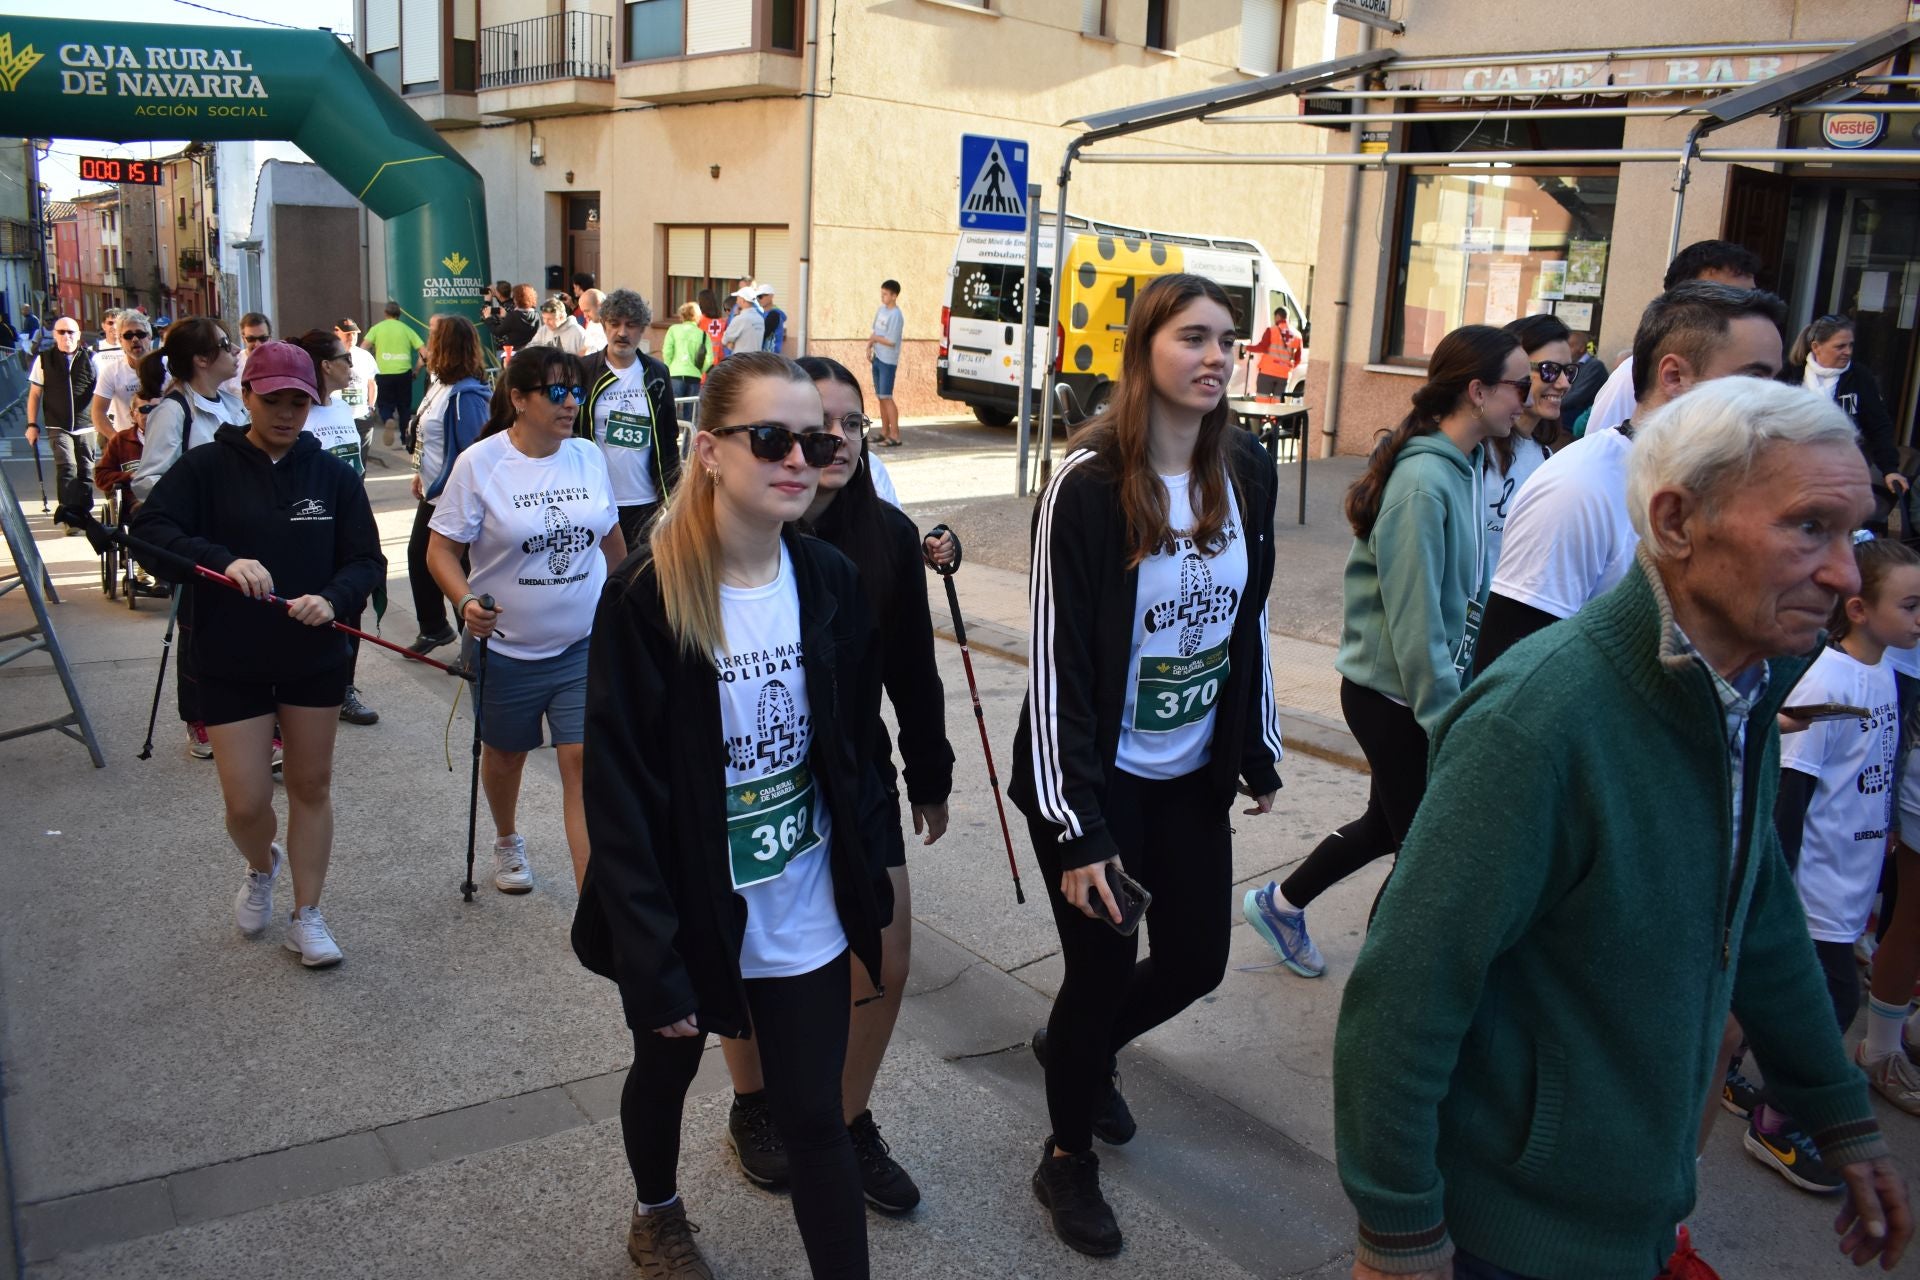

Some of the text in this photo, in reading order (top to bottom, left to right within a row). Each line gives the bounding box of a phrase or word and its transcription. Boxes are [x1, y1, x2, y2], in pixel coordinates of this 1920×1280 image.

[59, 44, 253, 71] CAJA RURAL
[1665, 57, 1782, 84] BAR
[61, 70, 269, 98] DE NAVARRA
[135, 104, 268, 117] ACCIÓN SOCIAL
[979, 250, 1026, 259] ambulanc
[424, 277, 484, 289] CAJA RURAL
[974, 283, 989, 296] 112
[423, 287, 481, 297] DE NAVARR
[612, 427, 643, 444] 433
[513, 487, 588, 502] CARRERA-MARCHA
[514, 493, 590, 509] SOLIDARIA
[1156, 678, 1218, 719] 370
[760, 787, 776, 796] CAJA
[751, 806, 807, 861] 369
